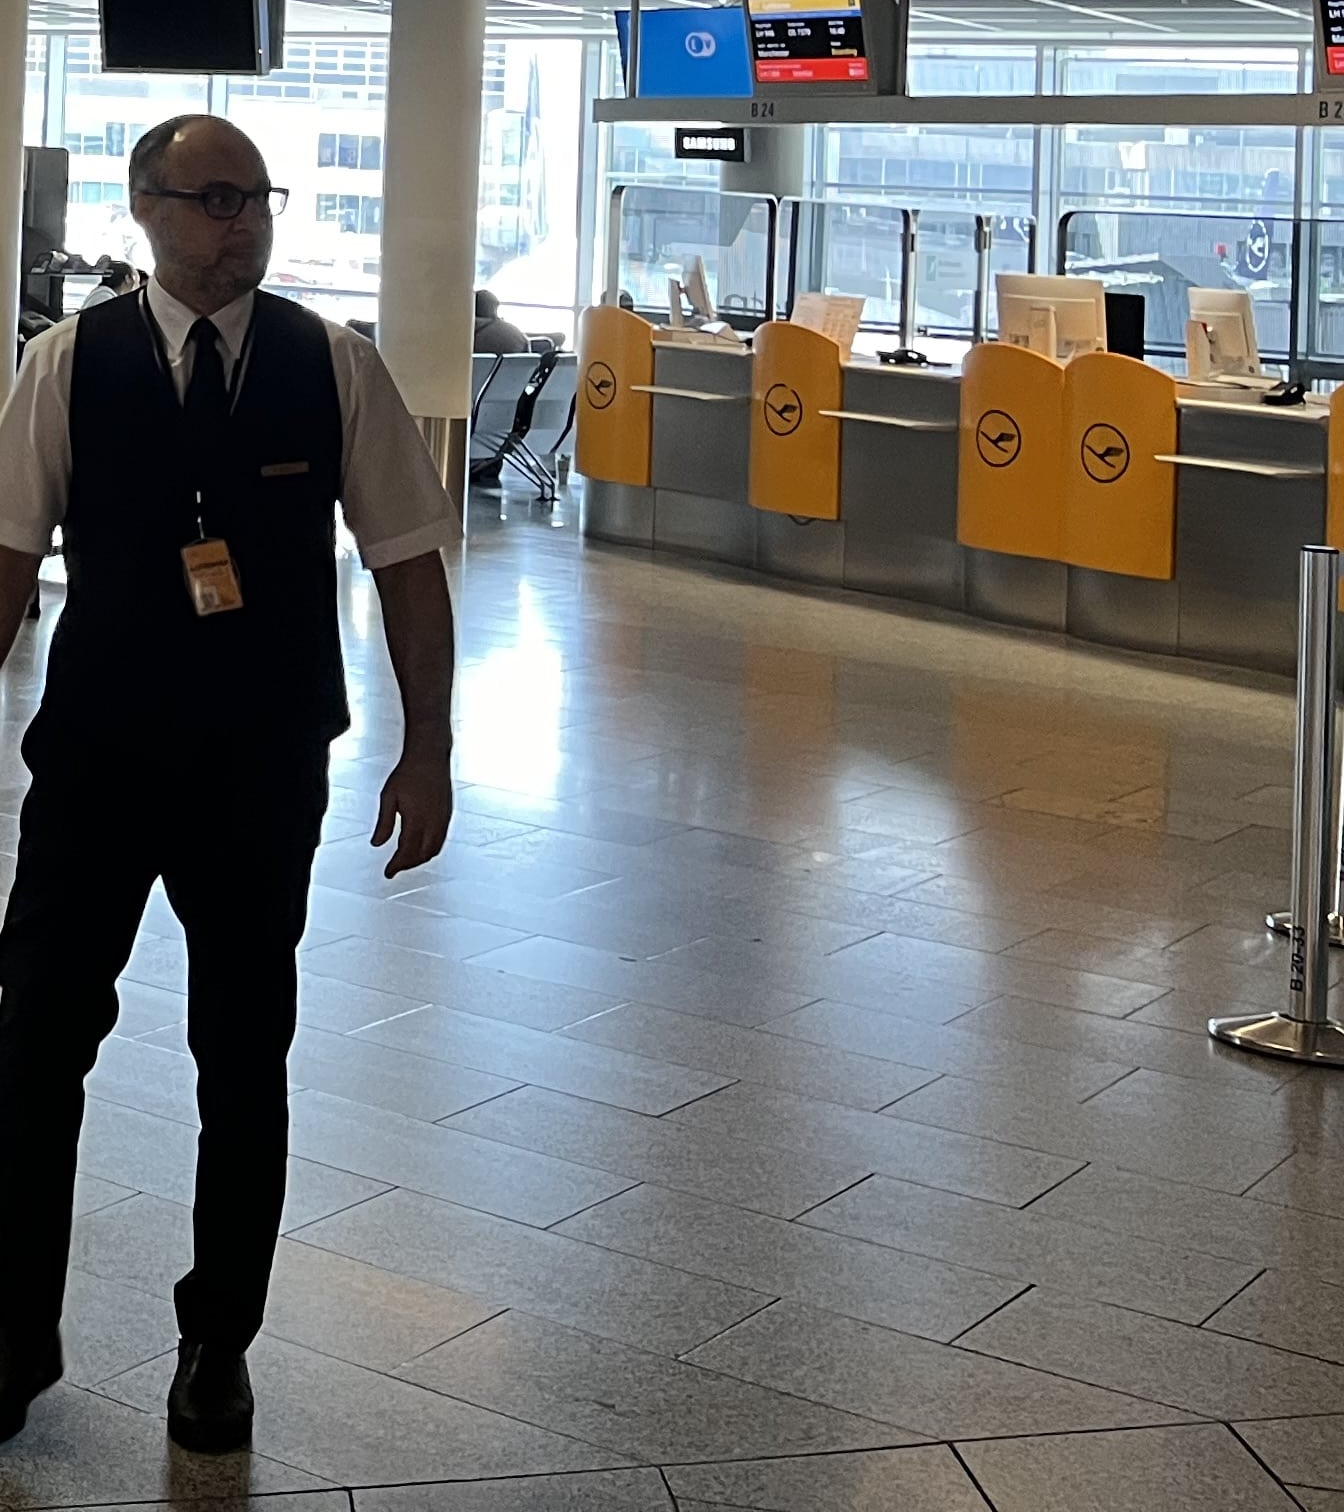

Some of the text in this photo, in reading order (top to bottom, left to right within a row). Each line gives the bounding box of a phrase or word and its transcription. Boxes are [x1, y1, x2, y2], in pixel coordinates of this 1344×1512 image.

[751, 102, 775, 118] B 24
[1318, 101, 1329, 119] B
[1290, 978, 1303, 993] B
